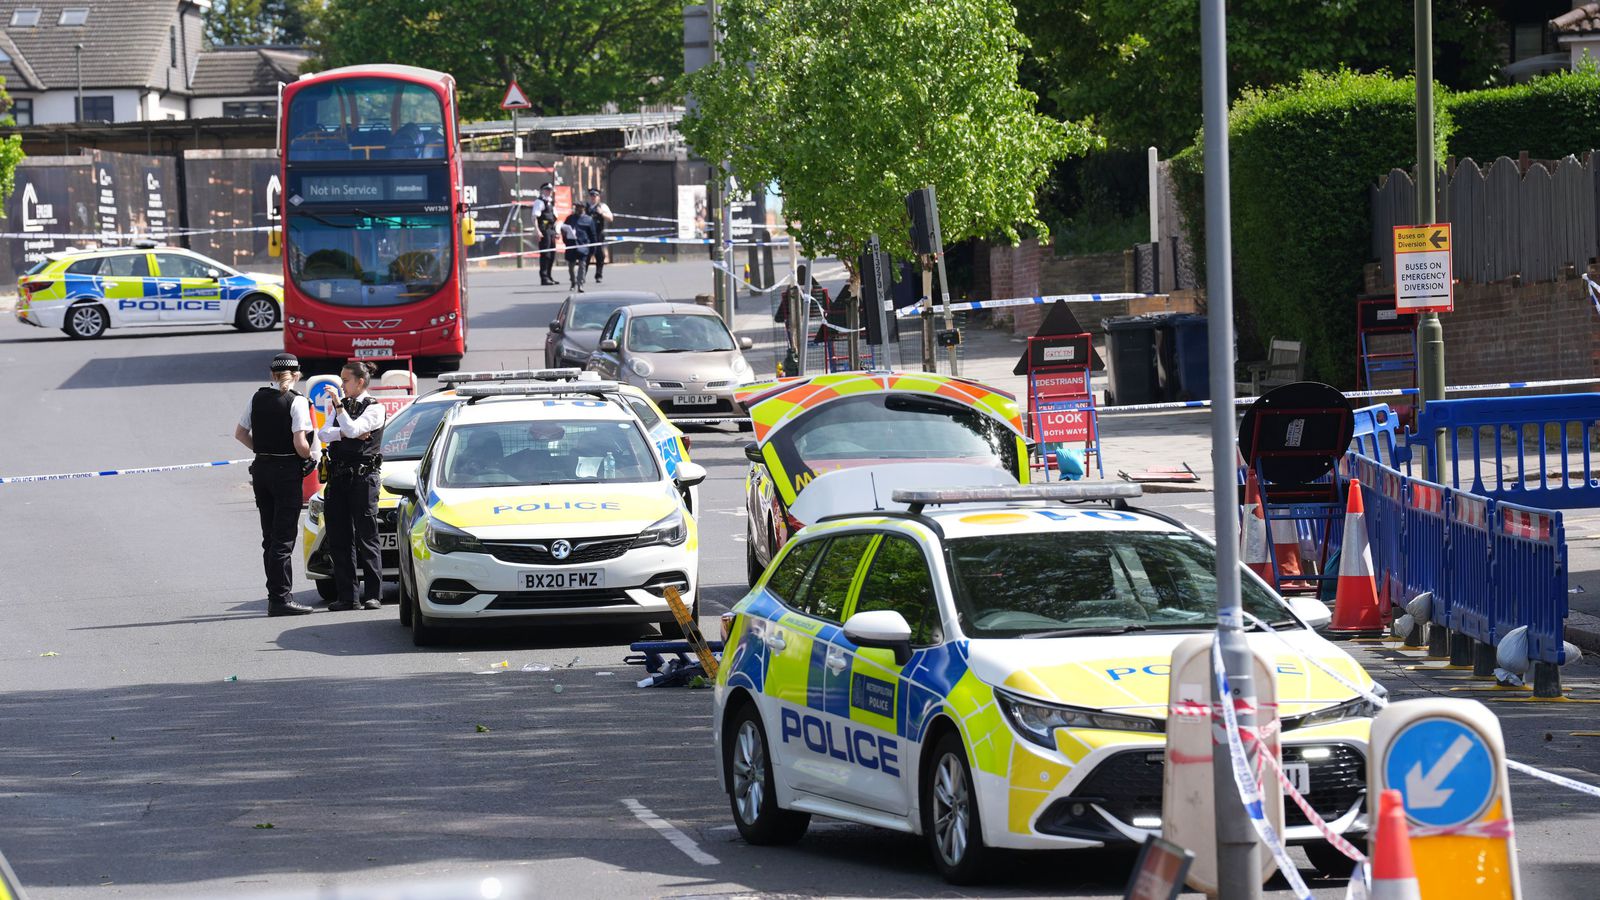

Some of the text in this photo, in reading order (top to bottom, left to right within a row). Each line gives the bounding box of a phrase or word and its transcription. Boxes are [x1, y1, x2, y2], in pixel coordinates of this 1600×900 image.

[310, 184, 377, 195] Not in Service
[1401, 272, 1446, 281] EMERGENCY
[1404, 283, 1444, 291] DIVERSION
[119, 299, 220, 311] POLICE
[352, 337, 395, 347] Metroline
[1035, 377, 1084, 387] EDESTRIANS
[678, 395, 712, 404] PL10 AYP
[1047, 413, 1083, 424] LOOK
[1066, 427, 1088, 435] WAYS
[493, 501, 621, 514] POLICE
[525, 572, 598, 588] BX20 FMZ
[1106, 663, 1303, 681] POE
[868, 696, 889, 711] POLICE
[781, 706, 900, 778] POLICE
